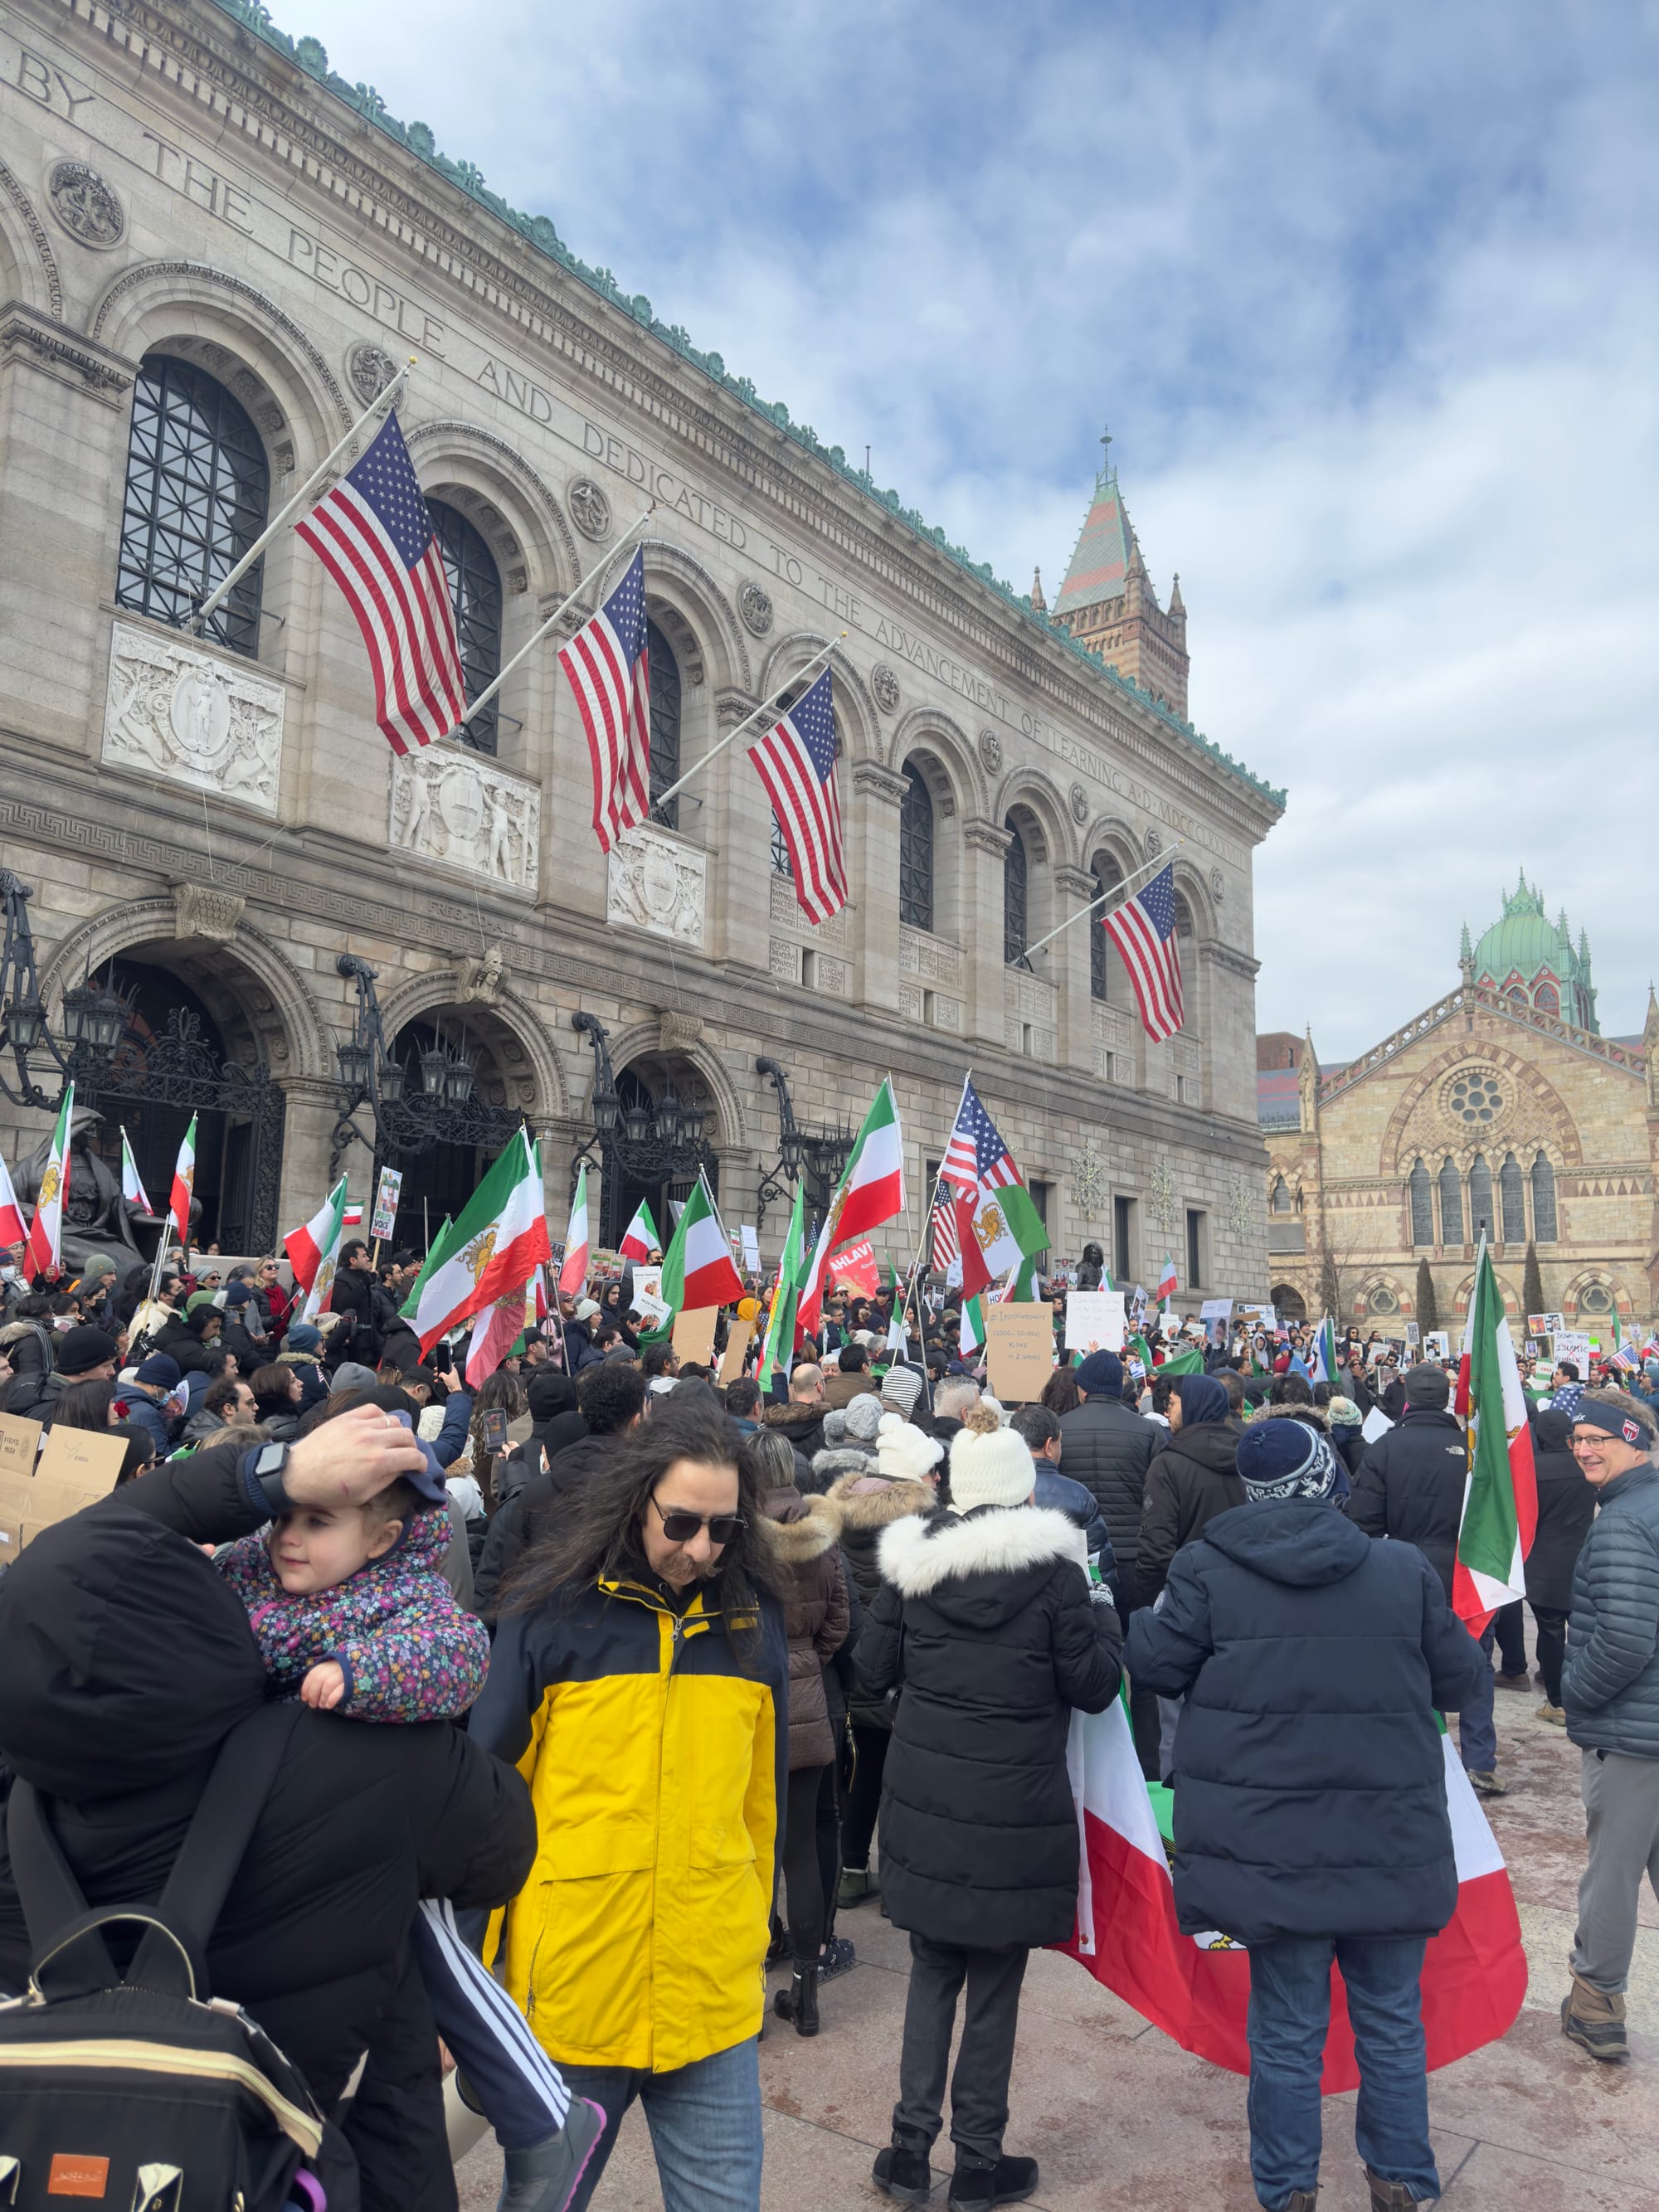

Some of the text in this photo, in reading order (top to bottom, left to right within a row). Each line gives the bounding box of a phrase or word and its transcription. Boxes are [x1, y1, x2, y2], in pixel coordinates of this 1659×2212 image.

[18, 50, 96, 120] BY
[142, 131, 254, 235] THE
[289, 229, 446, 358] PEOPLE
[477, 359, 552, 424] AND
[582, 421, 746, 550] DEDICATED
[770, 544, 803, 586] TO
[817, 576, 863, 628] THE
[876, 620, 1009, 719] ADVANCEMENT
[1022, 713, 1041, 739] OF
[1053, 732, 1121, 792] LEARNING
[771, 880, 791, 893] HOMER
[374, 1218, 389, 1229] VOICE
[830, 1242, 873, 1271] AHLAVI
[1556, 1344, 1588, 1353] ISLAMIC
